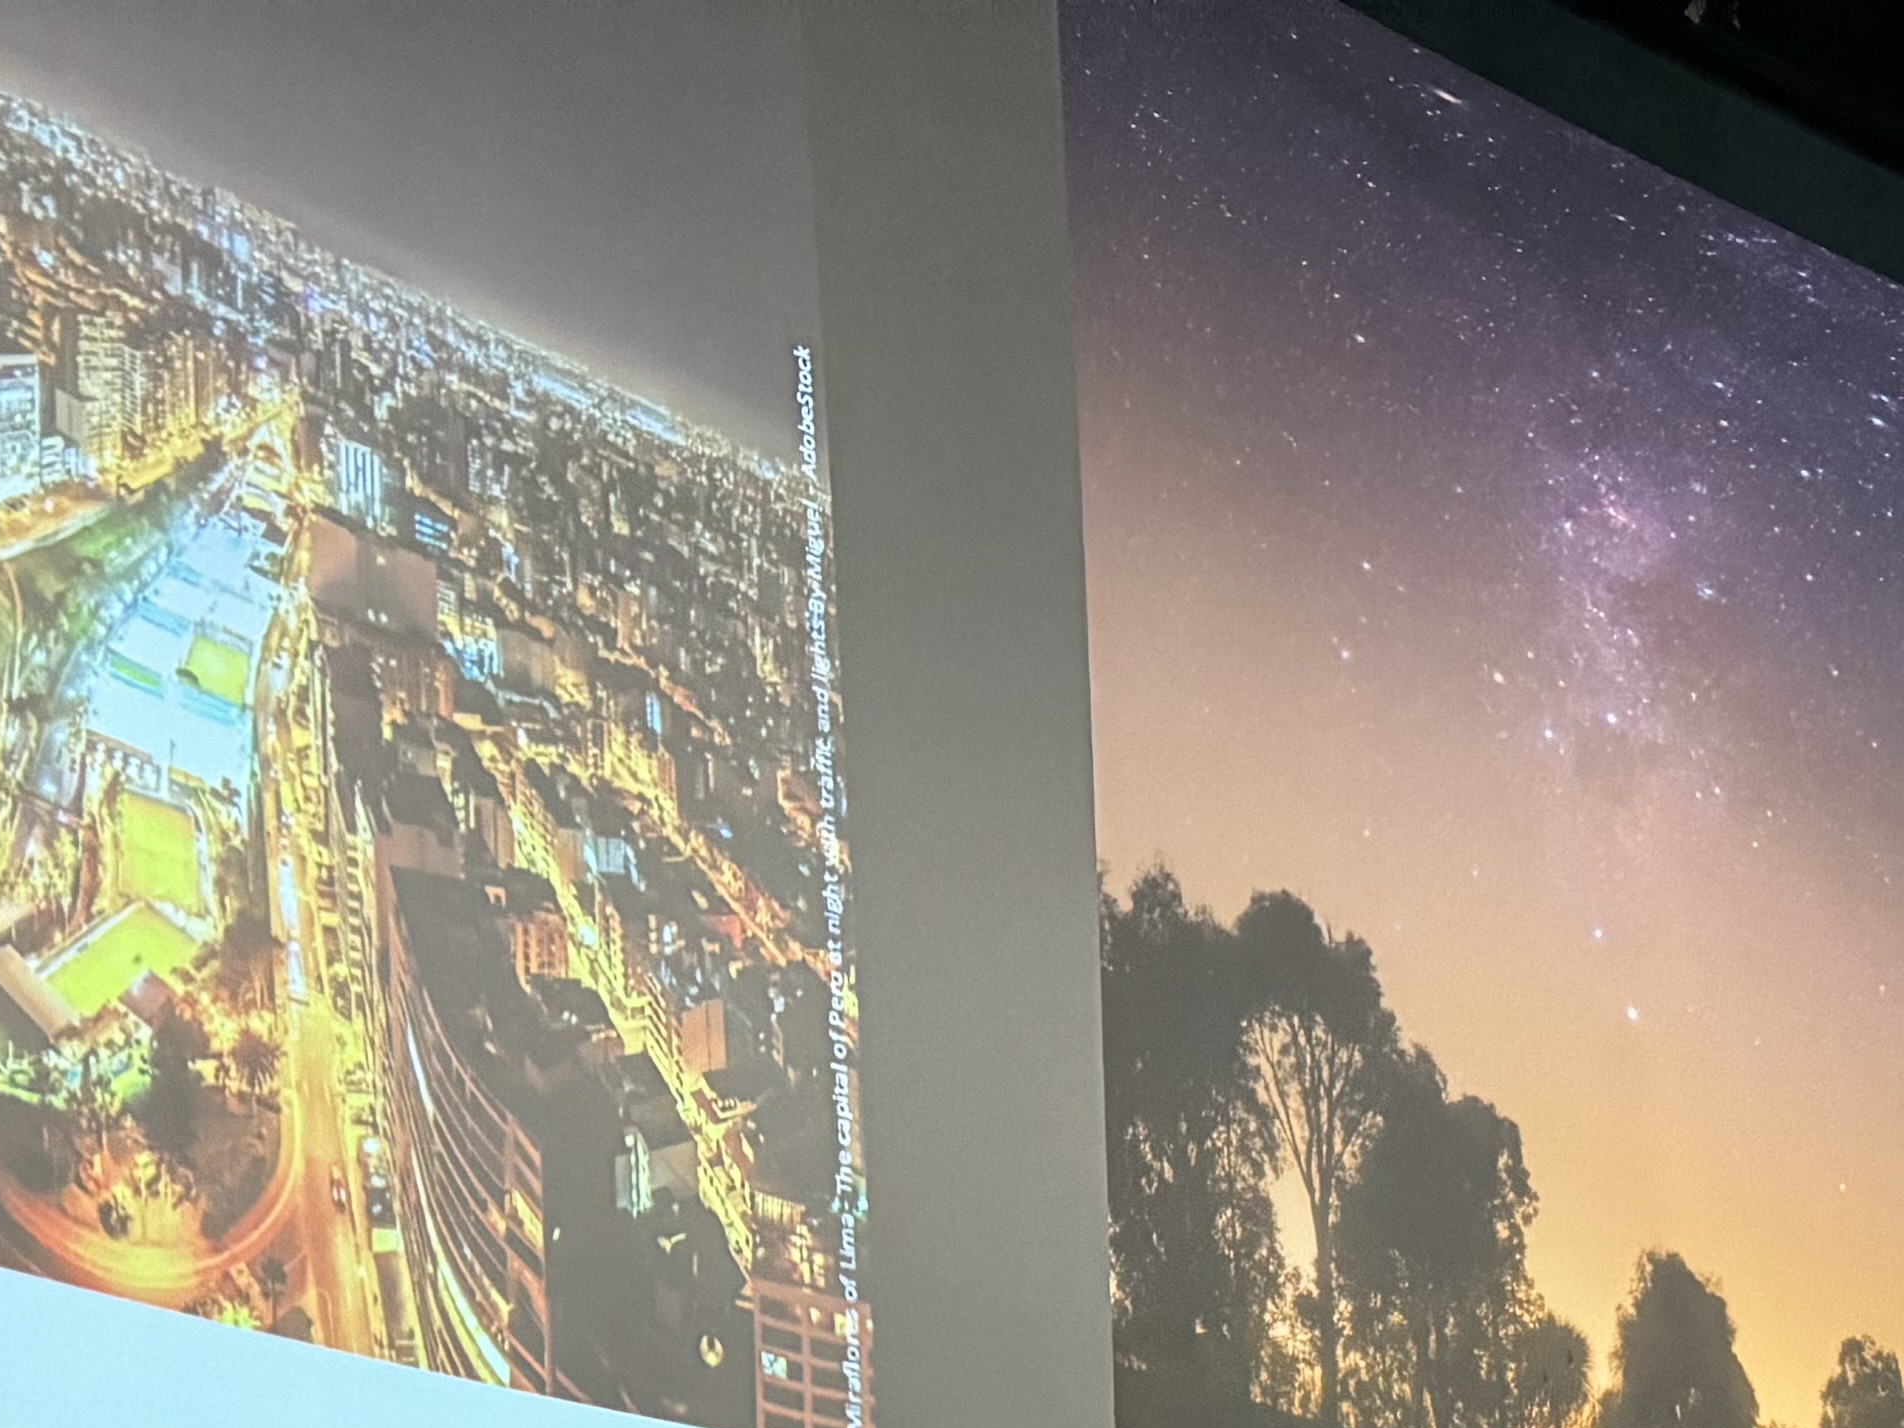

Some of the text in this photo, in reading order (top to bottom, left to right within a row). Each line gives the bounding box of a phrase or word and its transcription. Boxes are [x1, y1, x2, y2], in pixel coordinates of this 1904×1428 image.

[792, 344, 817, 482] AdobeStock
[801, 499, 825, 581] Miguel
[811, 688, 831, 733] and
[813, 740, 834, 810] traffic
[820, 873, 844, 934] night
[828, 1028, 848, 1060] of
[830, 1062, 853, 1147] capital
[834, 1150, 854, 1195] The
[838, 1214, 856, 1269] Lima
[839, 1275, 859, 1305] of
